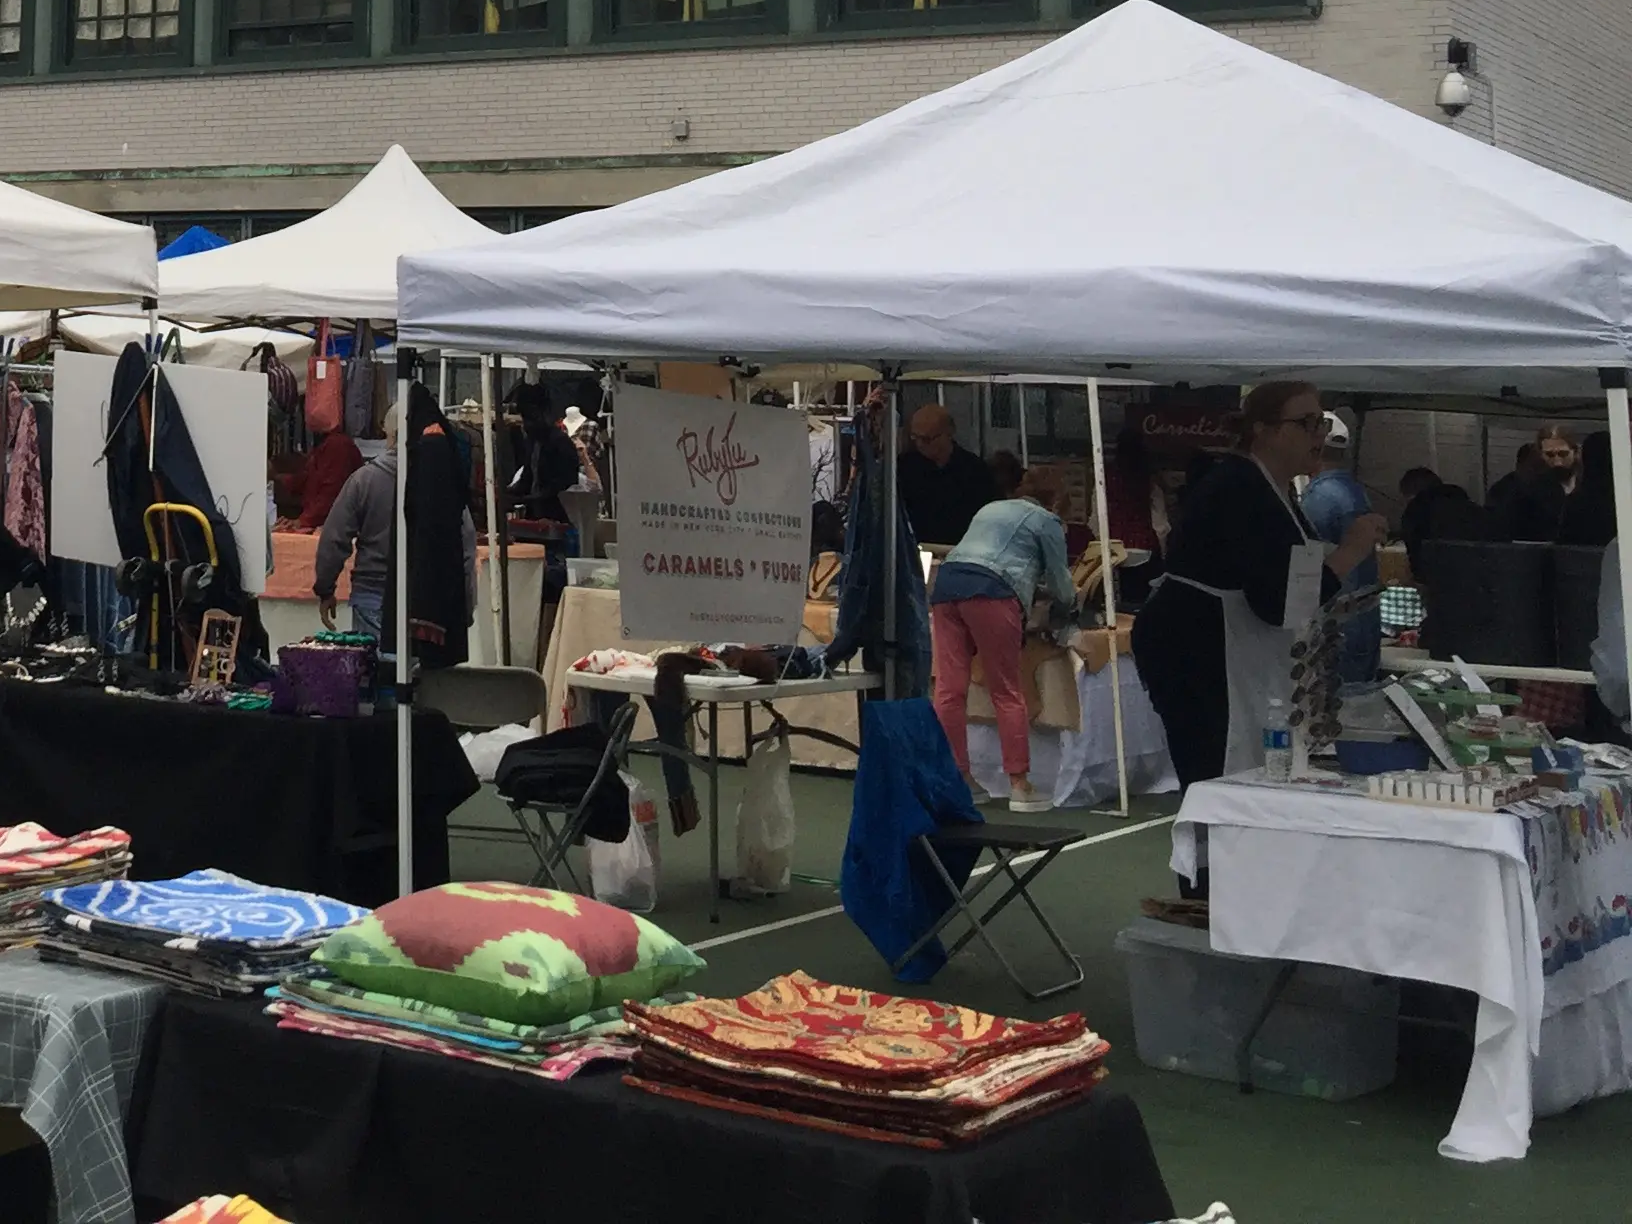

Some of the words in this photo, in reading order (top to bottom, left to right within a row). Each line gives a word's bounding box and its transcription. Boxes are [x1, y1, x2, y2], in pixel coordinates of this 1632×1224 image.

[640, 502, 732, 521] HANDCRAFTED
[735, 510, 802, 529] CONFECTIONS
[642, 552, 745, 579] CARAMELS
[761, 559, 802, 583] FUDGE
